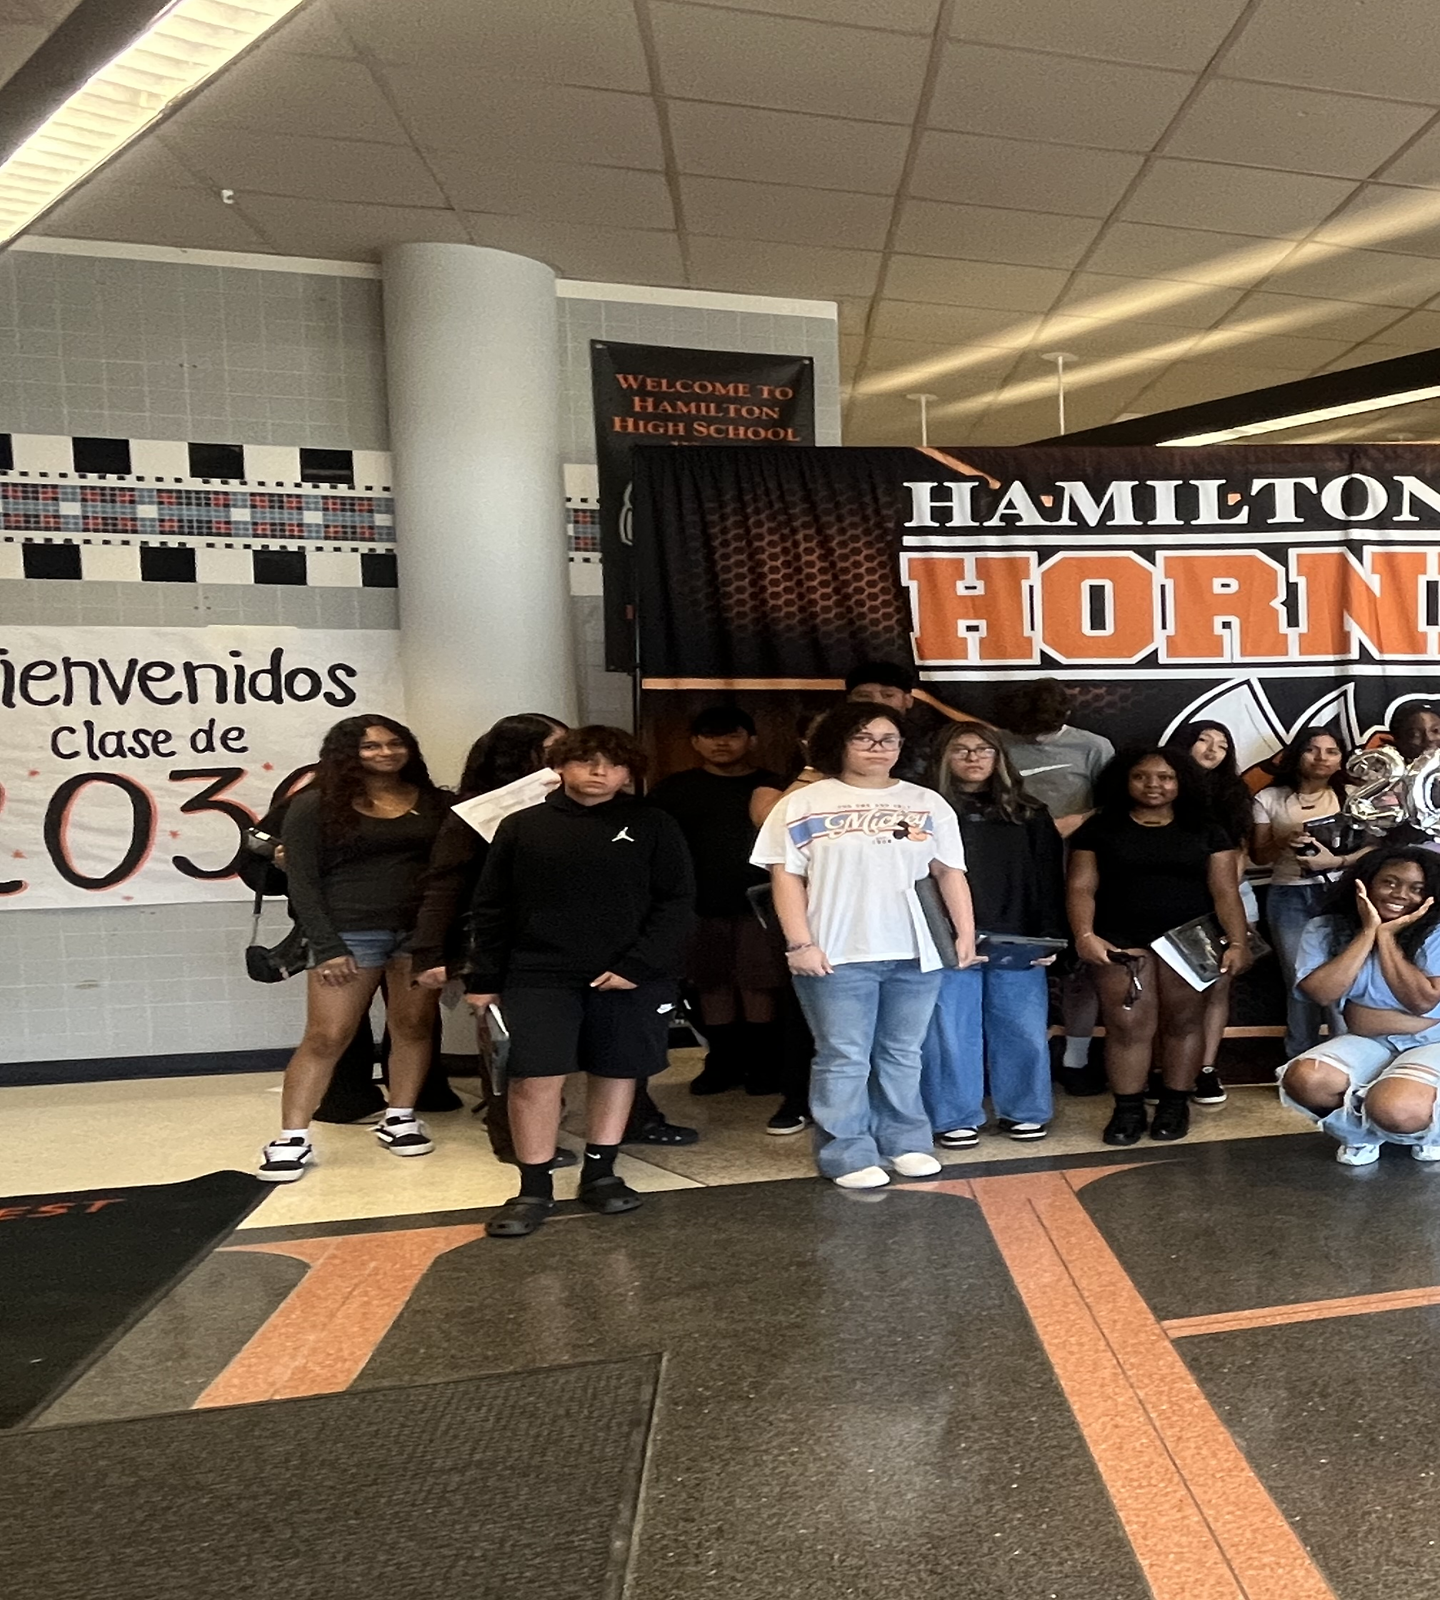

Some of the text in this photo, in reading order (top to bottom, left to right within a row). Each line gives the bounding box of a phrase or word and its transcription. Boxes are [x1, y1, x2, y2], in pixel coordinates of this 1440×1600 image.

[615, 373, 794, 400] WELCOME TO
[632, 396, 781, 420] HAMILTON
[612, 416, 800, 442] HIGH SCHOOL
[0, 648, 358, 708] ienvenidos
[190, 718, 249, 754] de
[0, 763, 318, 896] 03
[824, 808, 929, 840] Mickey
[0, 1198, 126, 1221] EST
